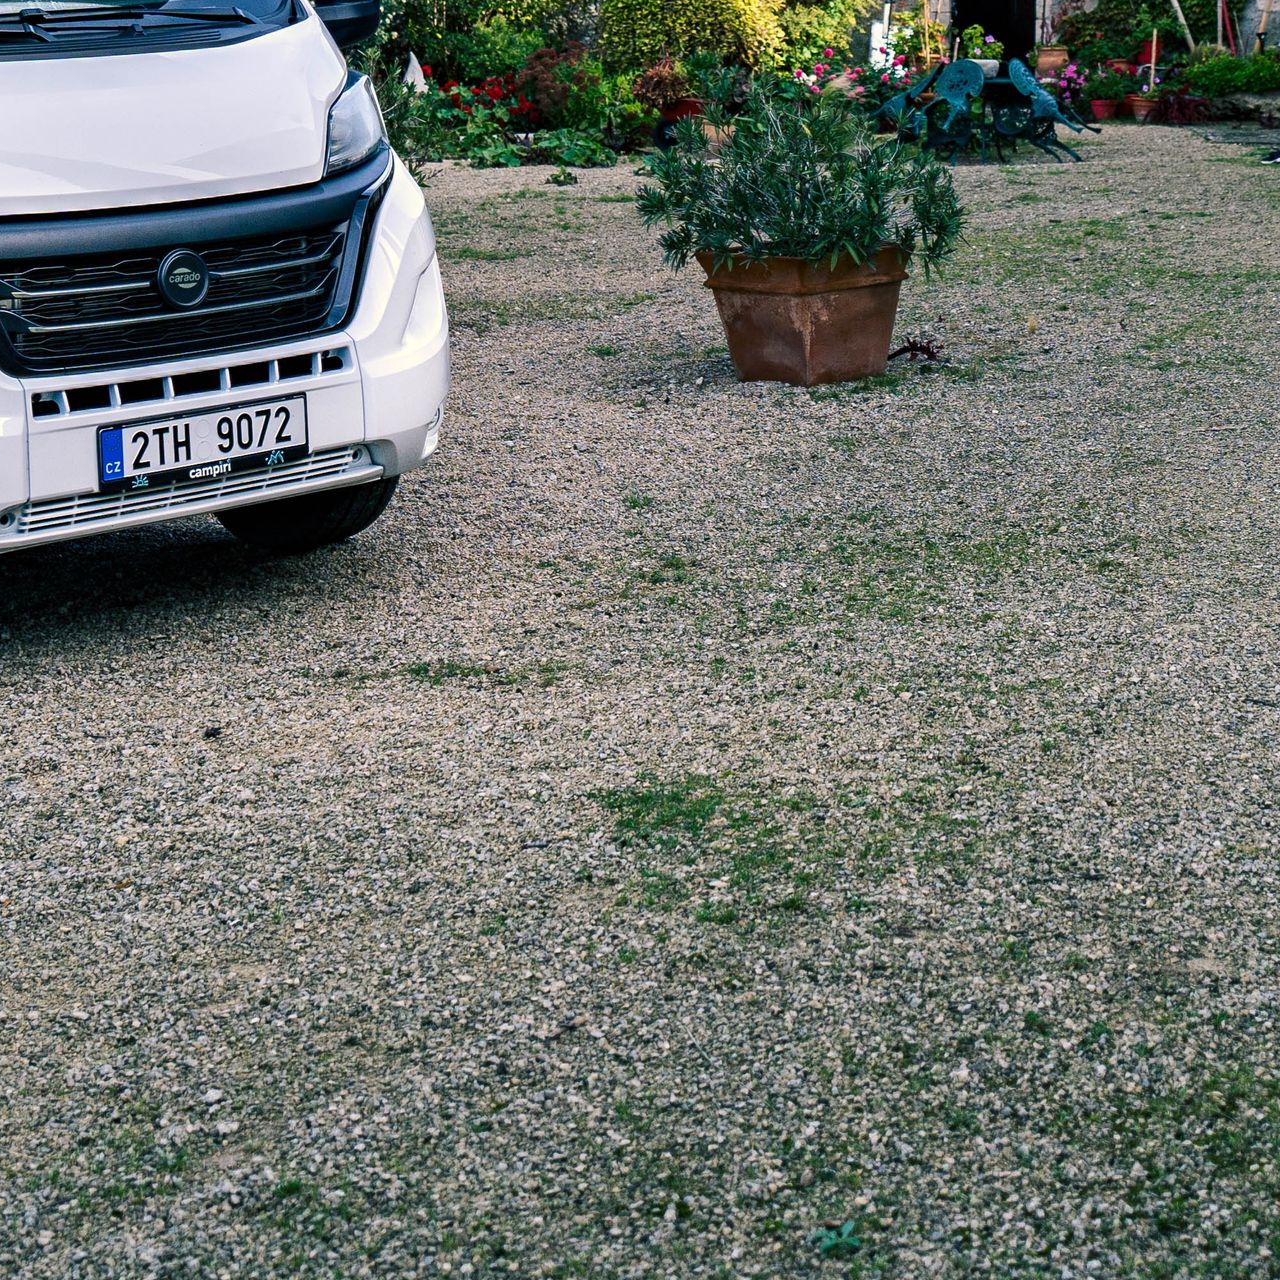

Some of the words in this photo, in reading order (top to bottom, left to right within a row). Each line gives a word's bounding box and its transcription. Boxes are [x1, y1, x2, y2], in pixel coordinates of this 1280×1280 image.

[169, 272, 201, 283] carado
[131, 423, 192, 470] 2TH
[216, 406, 292, 454] 9072
[106, 462, 121, 474] CZ
[189, 459, 231, 479] campiri
